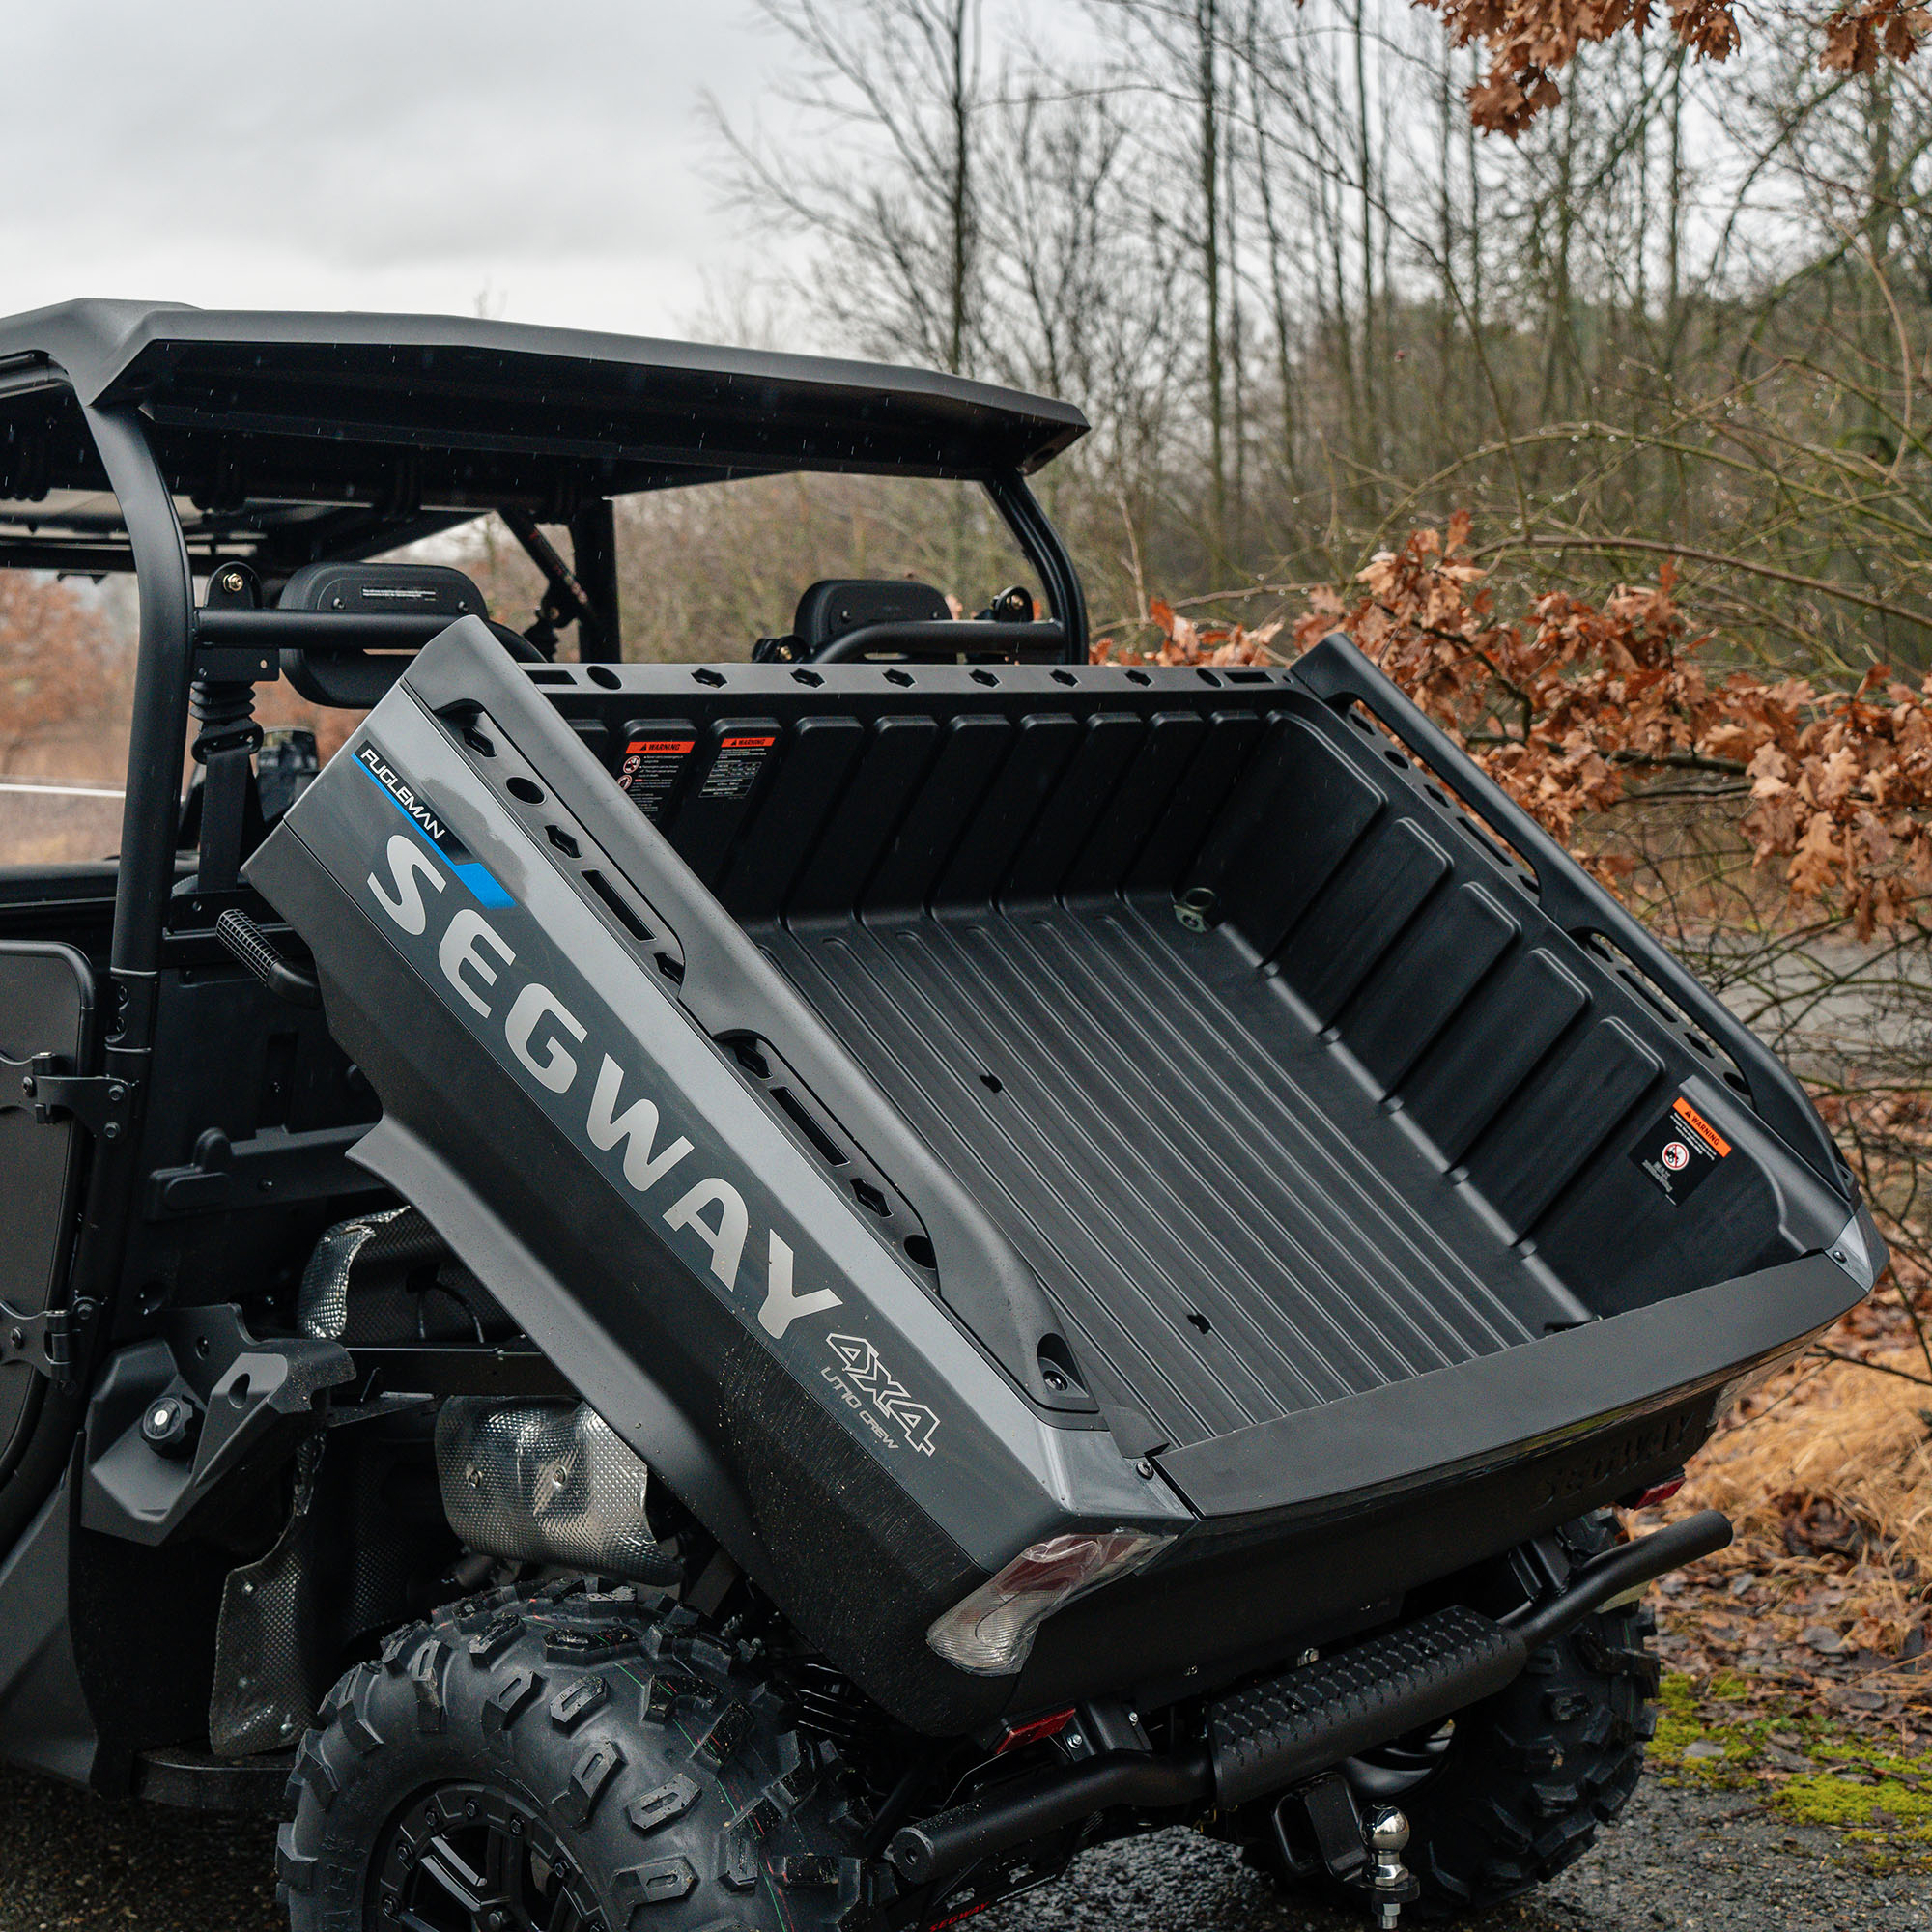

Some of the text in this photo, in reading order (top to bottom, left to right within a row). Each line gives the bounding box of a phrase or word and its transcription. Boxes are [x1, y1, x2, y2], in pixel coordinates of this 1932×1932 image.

[360, 748, 446, 840] FUGLEMAN
[367, 834, 843, 1340] SEGWAY
[1691, 1115, 1720, 1147] WARNING
[858, 1409, 900, 1449] CREW
[928, 1900, 990, 1932] SEGWAY
